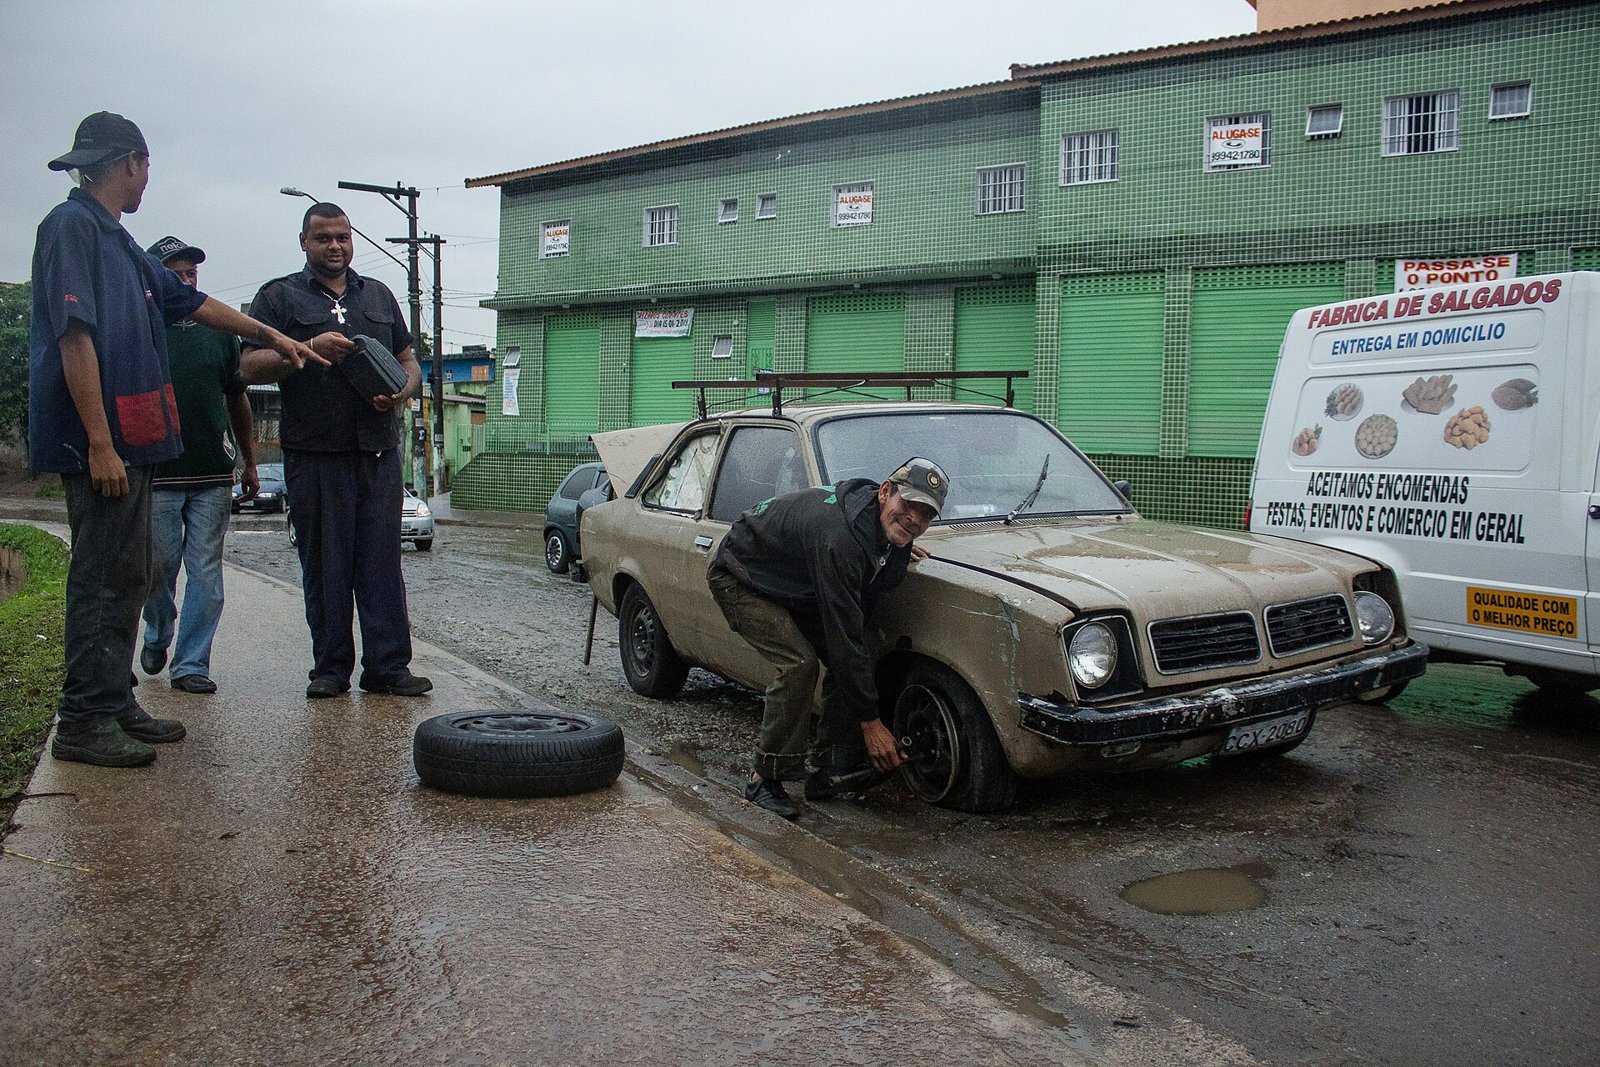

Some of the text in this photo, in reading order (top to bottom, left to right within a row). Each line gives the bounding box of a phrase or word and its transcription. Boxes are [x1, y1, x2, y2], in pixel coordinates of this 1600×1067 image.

[1403, 256, 1510, 271] PASSA-SE
[1407, 269, 1499, 285] O PONTO
[1307, 279, 1562, 329] FABRICA DE SALGADOS
[1331, 322, 1506, 356] ENTREGA EM DOMICILIO
[1306, 471, 1469, 505] ACEITAMOS ENCOMENDAS
[1266, 501, 1525, 544] FESTAS, EVENTOS E COMERCIO EM GERAL
[1474, 592, 1570, 615] QUALIDADE COM
[1472, 609, 1574, 636] O MELHOR PREÇO
